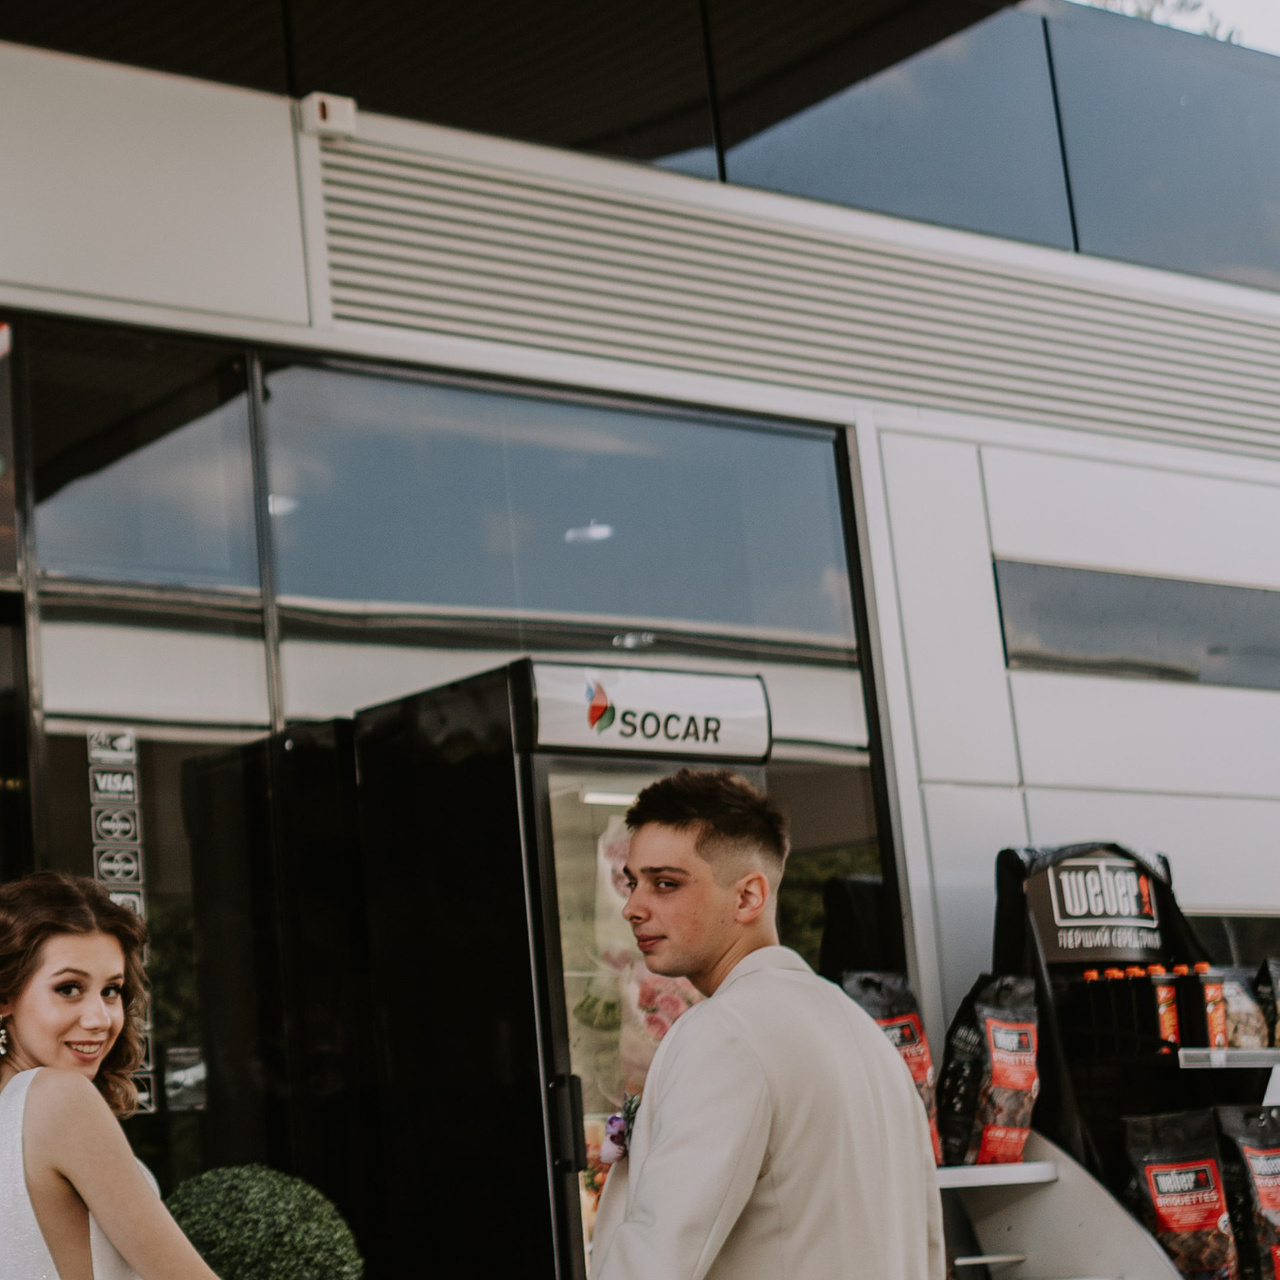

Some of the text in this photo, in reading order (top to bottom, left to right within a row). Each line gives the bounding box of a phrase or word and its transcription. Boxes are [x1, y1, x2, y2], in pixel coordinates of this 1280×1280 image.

[619, 710, 721, 742] SOCAR
[95, 773, 134, 793] VISA
[1059, 861, 1139, 916] weber
[1058, 926, 1111, 949] ПЕРШИЙ
[1156, 1170, 1196, 1192] weber
[1157, 1190, 1218, 1207] BRIQUETTES
